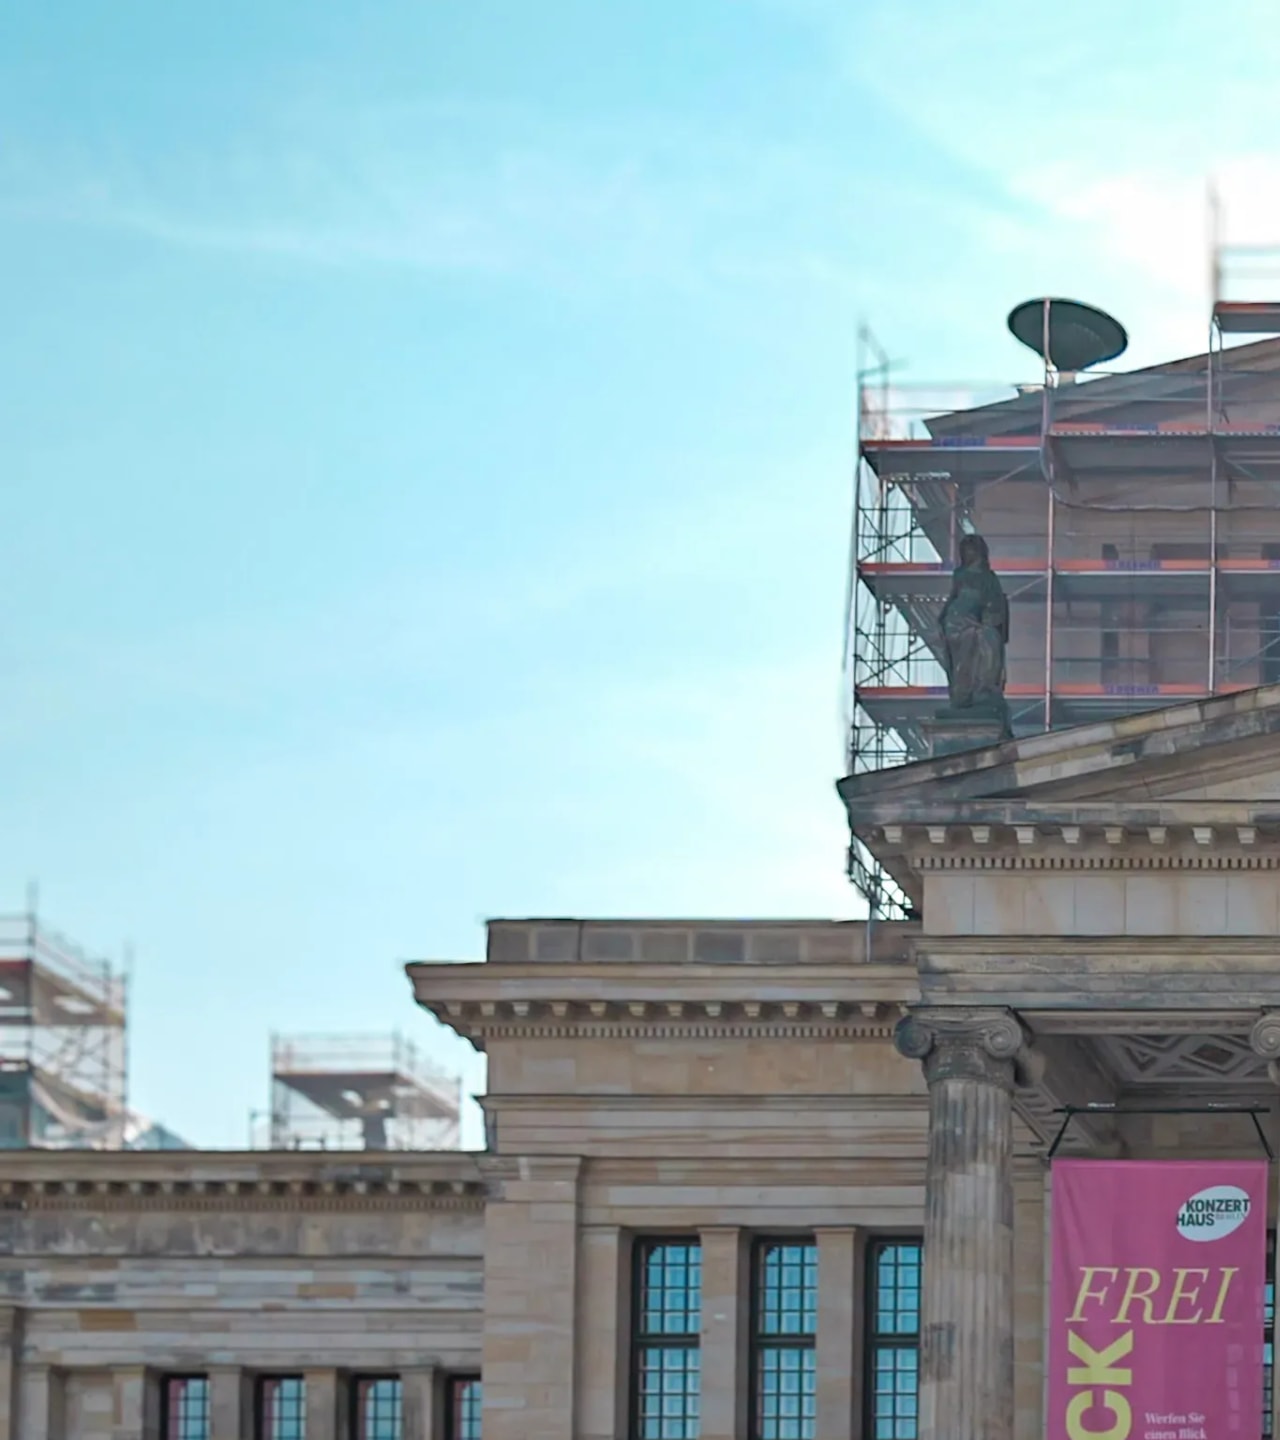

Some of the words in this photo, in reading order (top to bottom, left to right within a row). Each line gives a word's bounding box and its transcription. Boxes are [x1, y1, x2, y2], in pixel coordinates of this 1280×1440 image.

[1186, 1199, 1250, 1213] KONZERT
[1176, 1213, 1215, 1227] HAUS
[1065, 1266, 1239, 1324] FREI
